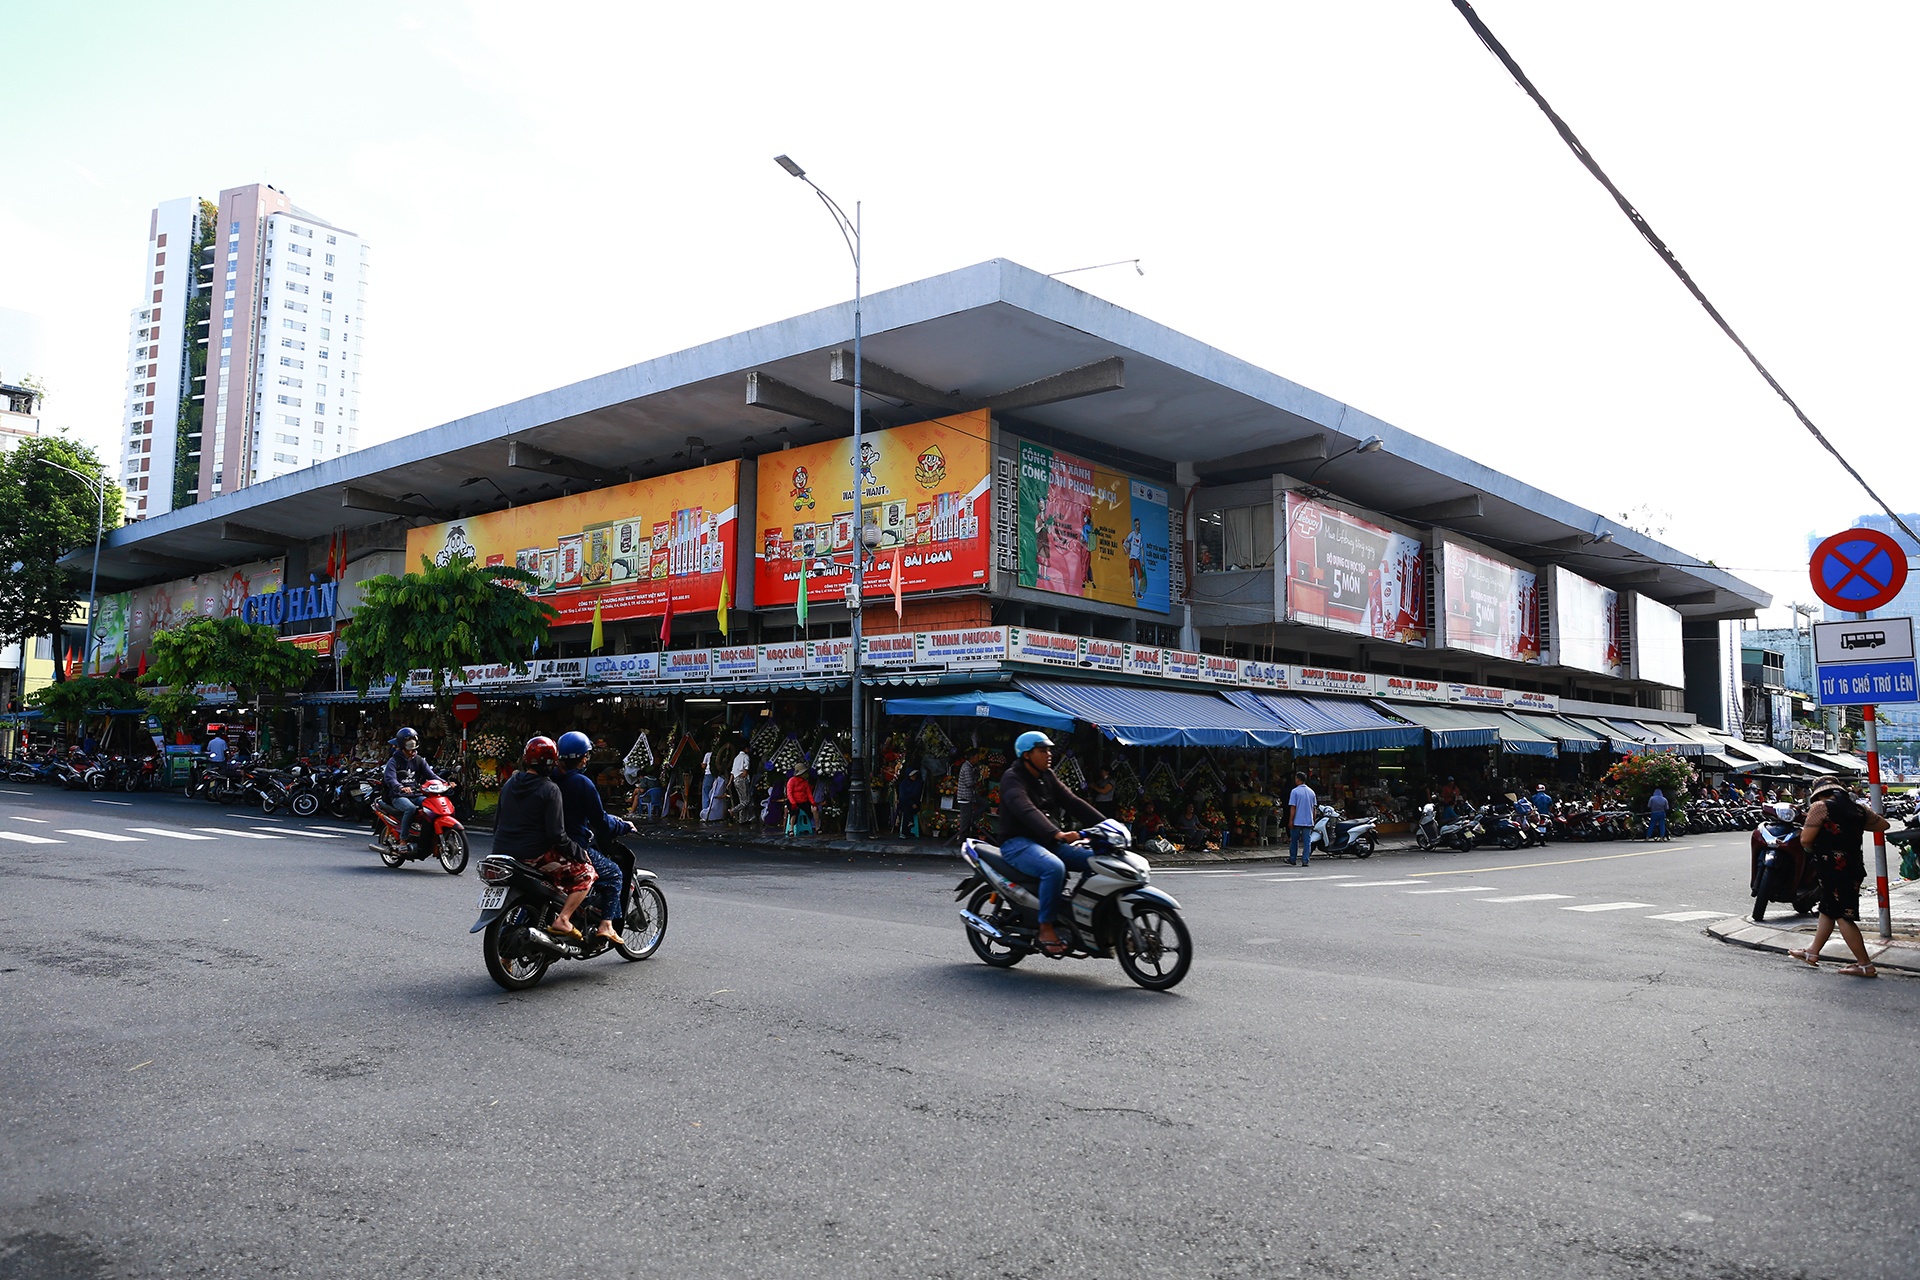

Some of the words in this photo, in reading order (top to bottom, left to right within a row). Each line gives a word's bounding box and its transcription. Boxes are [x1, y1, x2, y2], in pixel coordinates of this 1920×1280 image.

[1022, 448, 1046, 466] CÔNG
[1048, 456, 1066, 472] DÂN
[1067, 463, 1091, 480] XANH
[1021, 463, 1046, 482] CÔNG
[1049, 471, 1066, 488] DÂN
[1068, 478, 1096, 497] PHONG
[904, 552, 922, 567] ĐÀI
[925, 550, 953, 564] LOAN
[1333, 569, 1341, 598] 5
[1342, 572, 1360, 594] MÓN
[287, 573, 339, 623] HÀN
[869, 637, 891, 652] HUỲNH
[931, 633, 960, 647] THANH
[962, 629, 1002, 645] PHƯƠNG
[1026, 633, 1048, 648] THANH
[672, 652, 693, 667] QUỲNH
[720, 650, 738, 664] NGỌC
[739, 647, 756, 660] CHÂU
[766, 648, 788, 663] NGỌC
[788, 645, 805, 659] LIÊN
[556, 662, 580, 673] KIM
[638, 659, 650, 669] 13
[1822, 676, 1834, 695] TỪ
[1838, 678, 1848, 694] 16
[1852, 672, 1870, 694] CHỖ
[1873, 672, 1891, 693] TRỞ
[1894, 672, 1913, 692] LÊN
